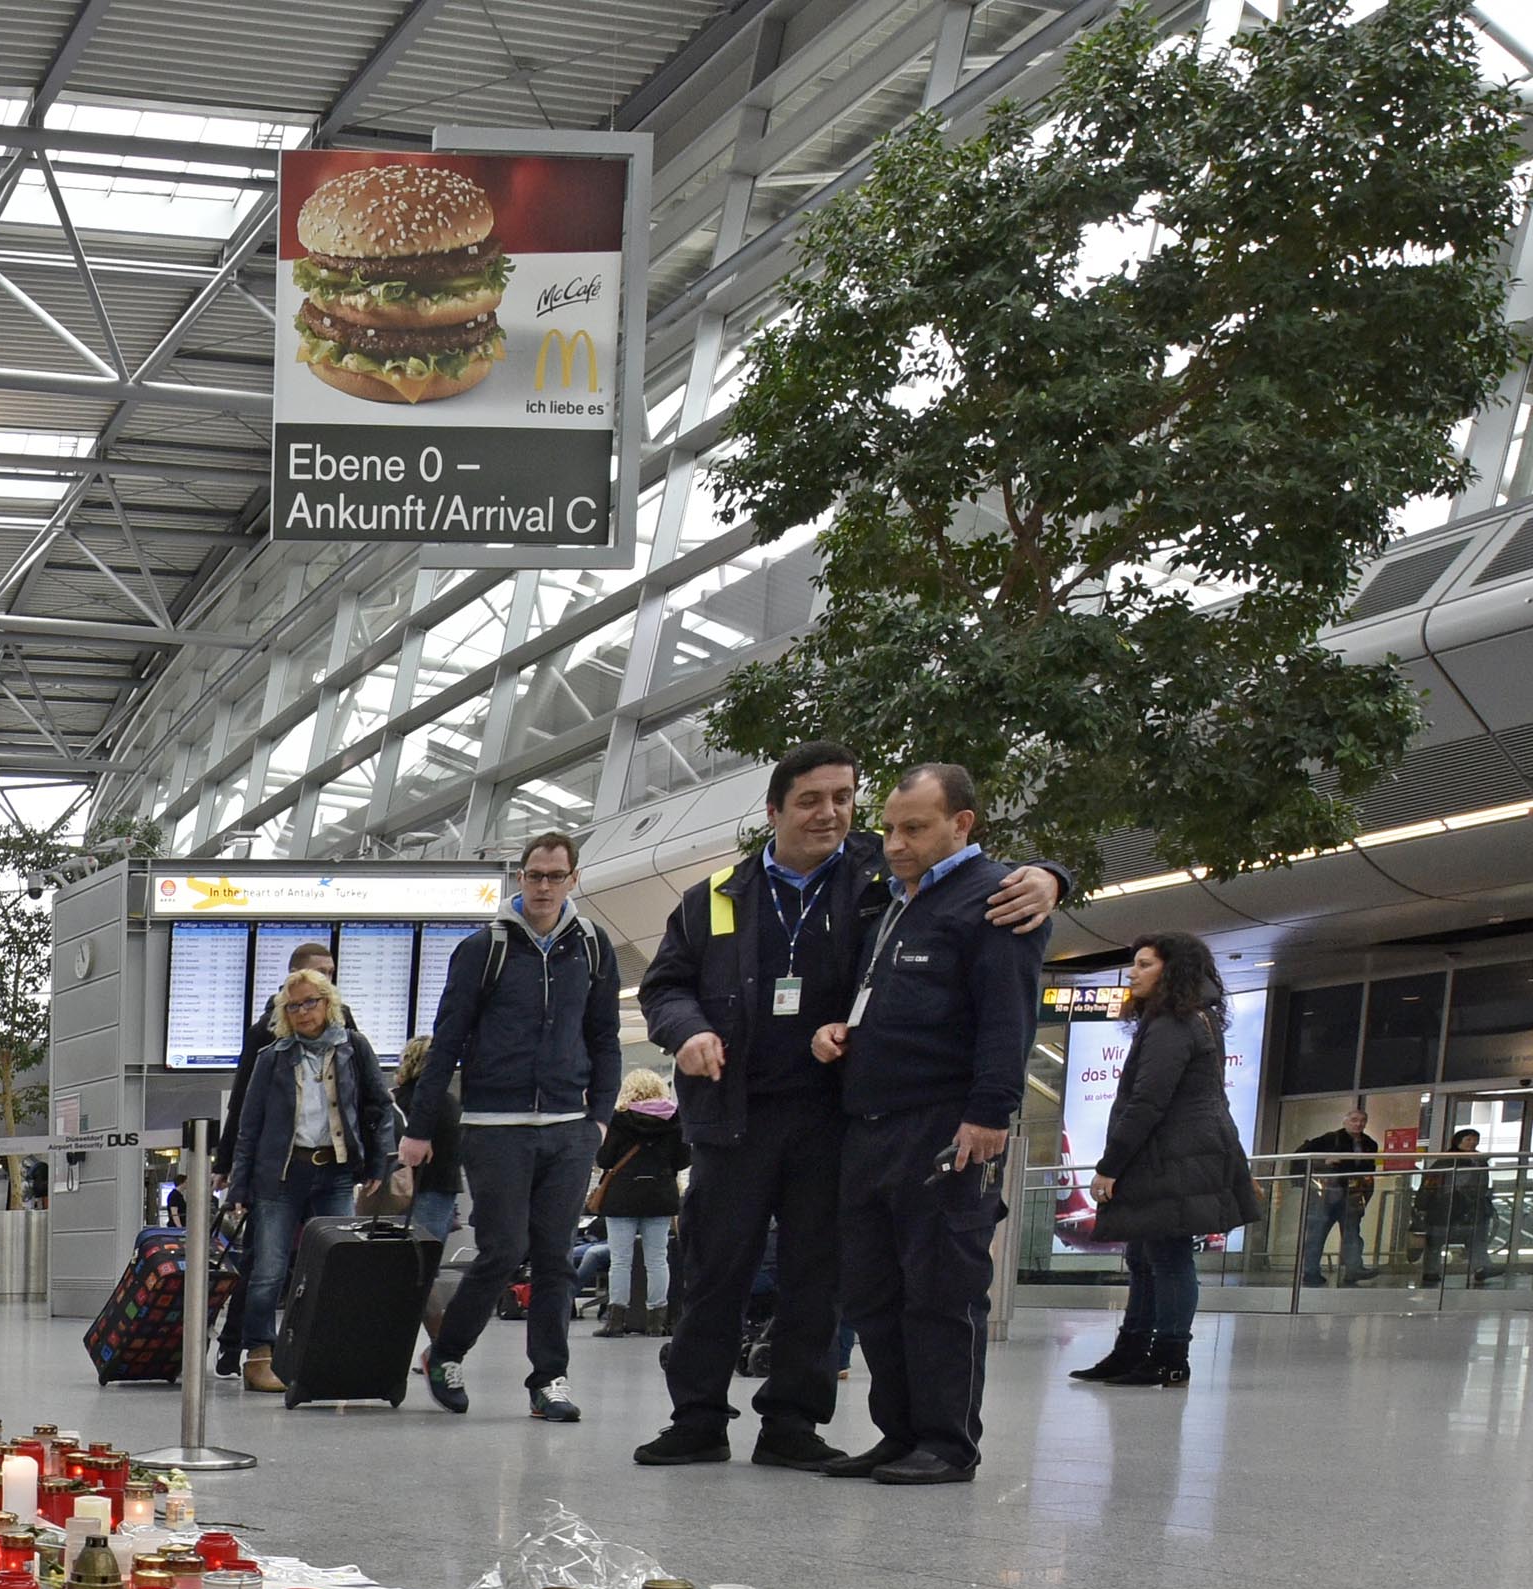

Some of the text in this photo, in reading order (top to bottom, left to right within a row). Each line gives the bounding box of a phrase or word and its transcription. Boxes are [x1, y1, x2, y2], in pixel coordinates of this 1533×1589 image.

[537, 274, 602, 315] McCafé
[526, 400, 604, 415] ich liebe es
[288, 443, 405, 482] Ebene
[419, 447, 443, 482] 0
[286, 492, 597, 533] Ankunft/Arrival C
[223, 887, 240, 897] the
[243, 888, 270, 897] heart
[274, 888, 284, 897] of
[287, 887, 324, 899] Antalya
[1103, 1047, 1125, 1060] Wir
[1082, 1068, 1107, 1081] das
[107, 1133, 138, 1147] DUS
